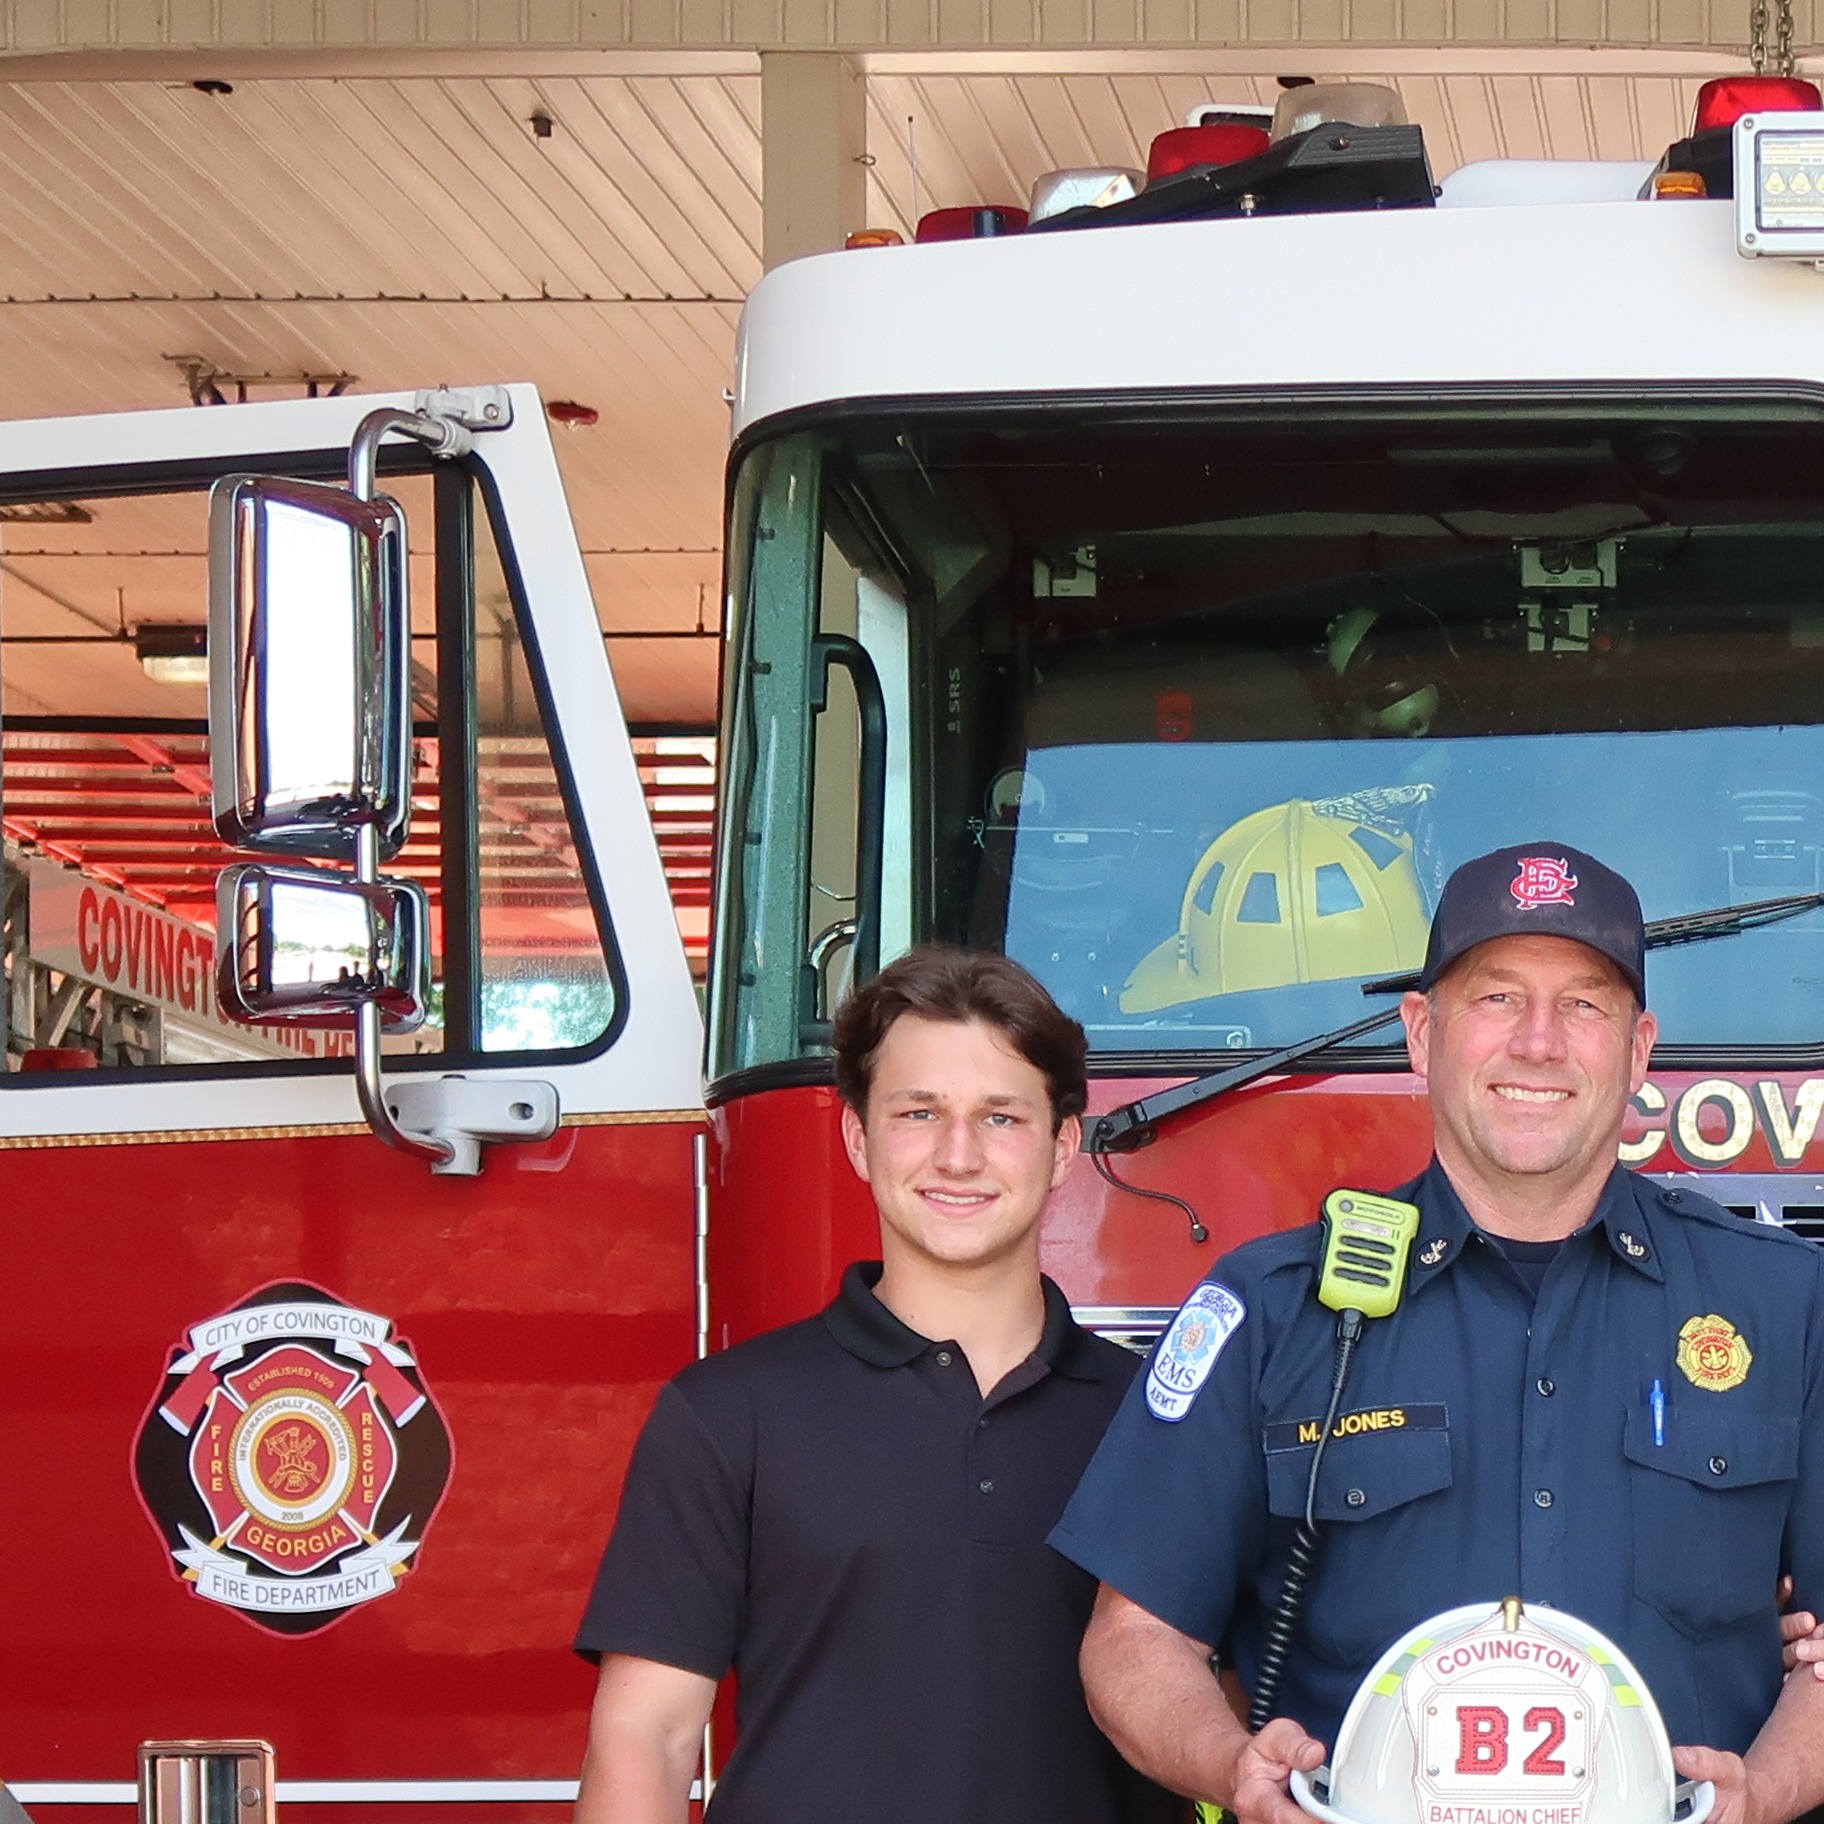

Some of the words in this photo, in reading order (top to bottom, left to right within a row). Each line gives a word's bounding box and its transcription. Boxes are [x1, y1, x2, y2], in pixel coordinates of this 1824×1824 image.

[77, 886, 252, 1032] COVINGT
[205, 1320, 243, 1347] CITY
[246, 1314, 269, 1335] OF
[273, 1312, 376, 1339] COVINGTON
[247, 1366, 311, 1391] ESTABLISHED
[1157, 1352, 1196, 1389] EMS
[1149, 1386, 1178, 1411] AEMT
[238, 1399, 304, 1461] INTERNATIONALLY
[306, 1403, 347, 1461] ACCREDITED
[1298, 1421, 1321, 1444] M.
[1332, 1409, 1406, 1438] JONES
[210, 1425, 223, 1492] FIRE
[361, 1412, 374, 1504] RESCUE
[246, 1524, 347, 1557] GEORGIA
[212, 1574, 249, 1601] FIRE
[255, 1569, 380, 1605] DEPARTMENT
[1436, 1639, 1581, 1679] COVINGTON
[1455, 1705, 1566, 1776] B2
[1532, 1807, 1581, 1824] CHIEF
